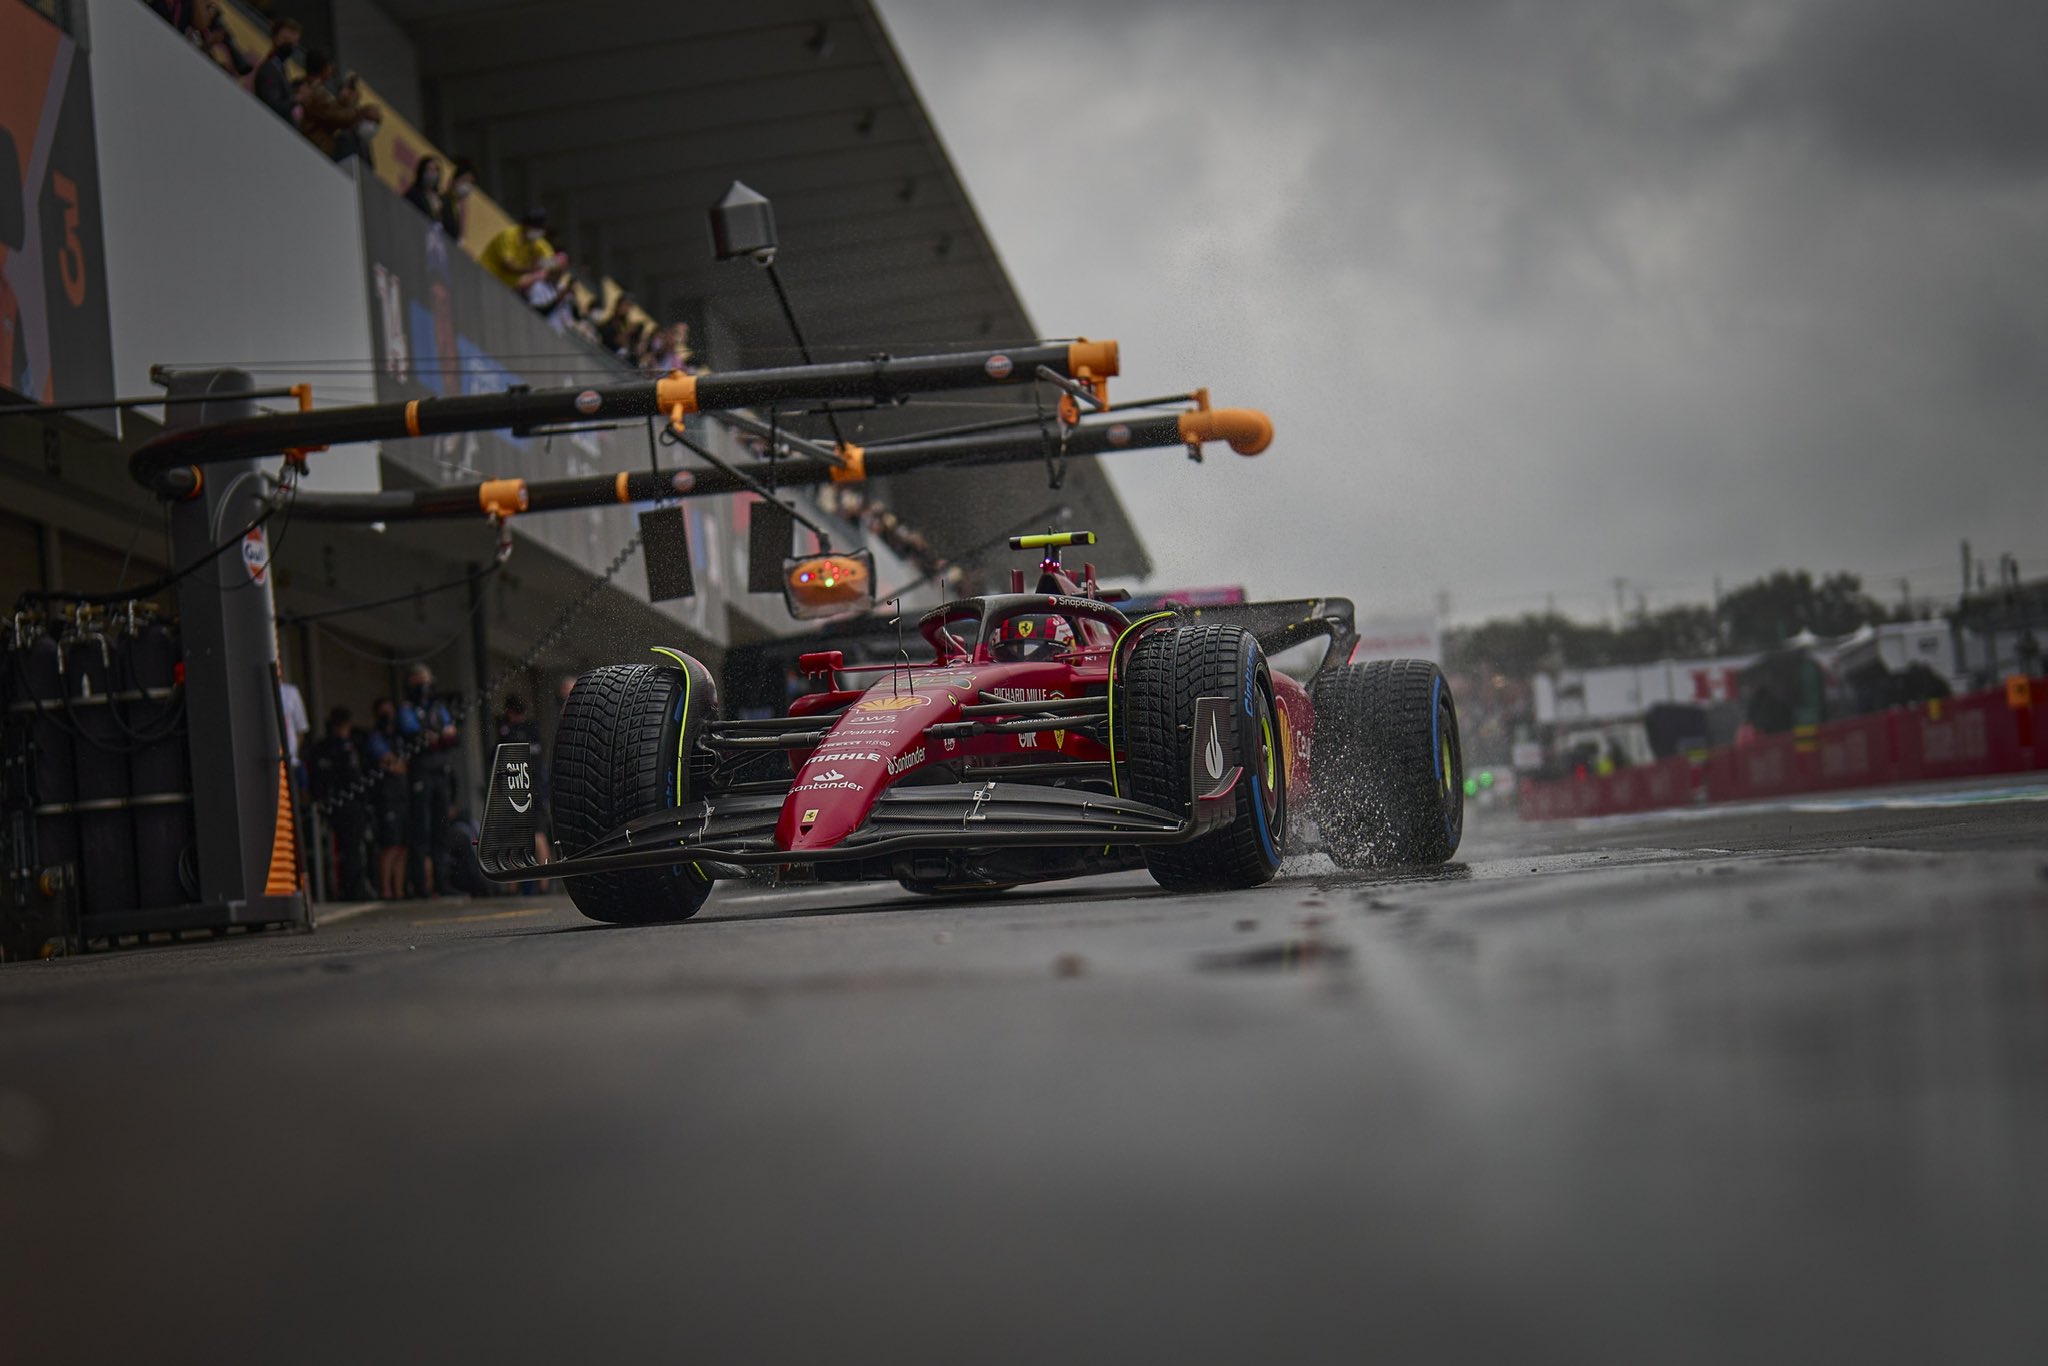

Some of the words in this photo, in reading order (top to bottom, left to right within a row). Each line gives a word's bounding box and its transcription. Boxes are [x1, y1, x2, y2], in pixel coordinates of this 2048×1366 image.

[1058, 596, 1106, 612] Snapdragon
[993, 687, 1025, 702] RICHARD
[1026, 688, 1047, 702] MILLE
[850, 714, 898, 724] aws
[841, 728, 900, 738] Palantir
[804, 751, 882, 766] MAHLE
[893, 746, 926, 775] Santander
[506, 762, 530, 790] aws
